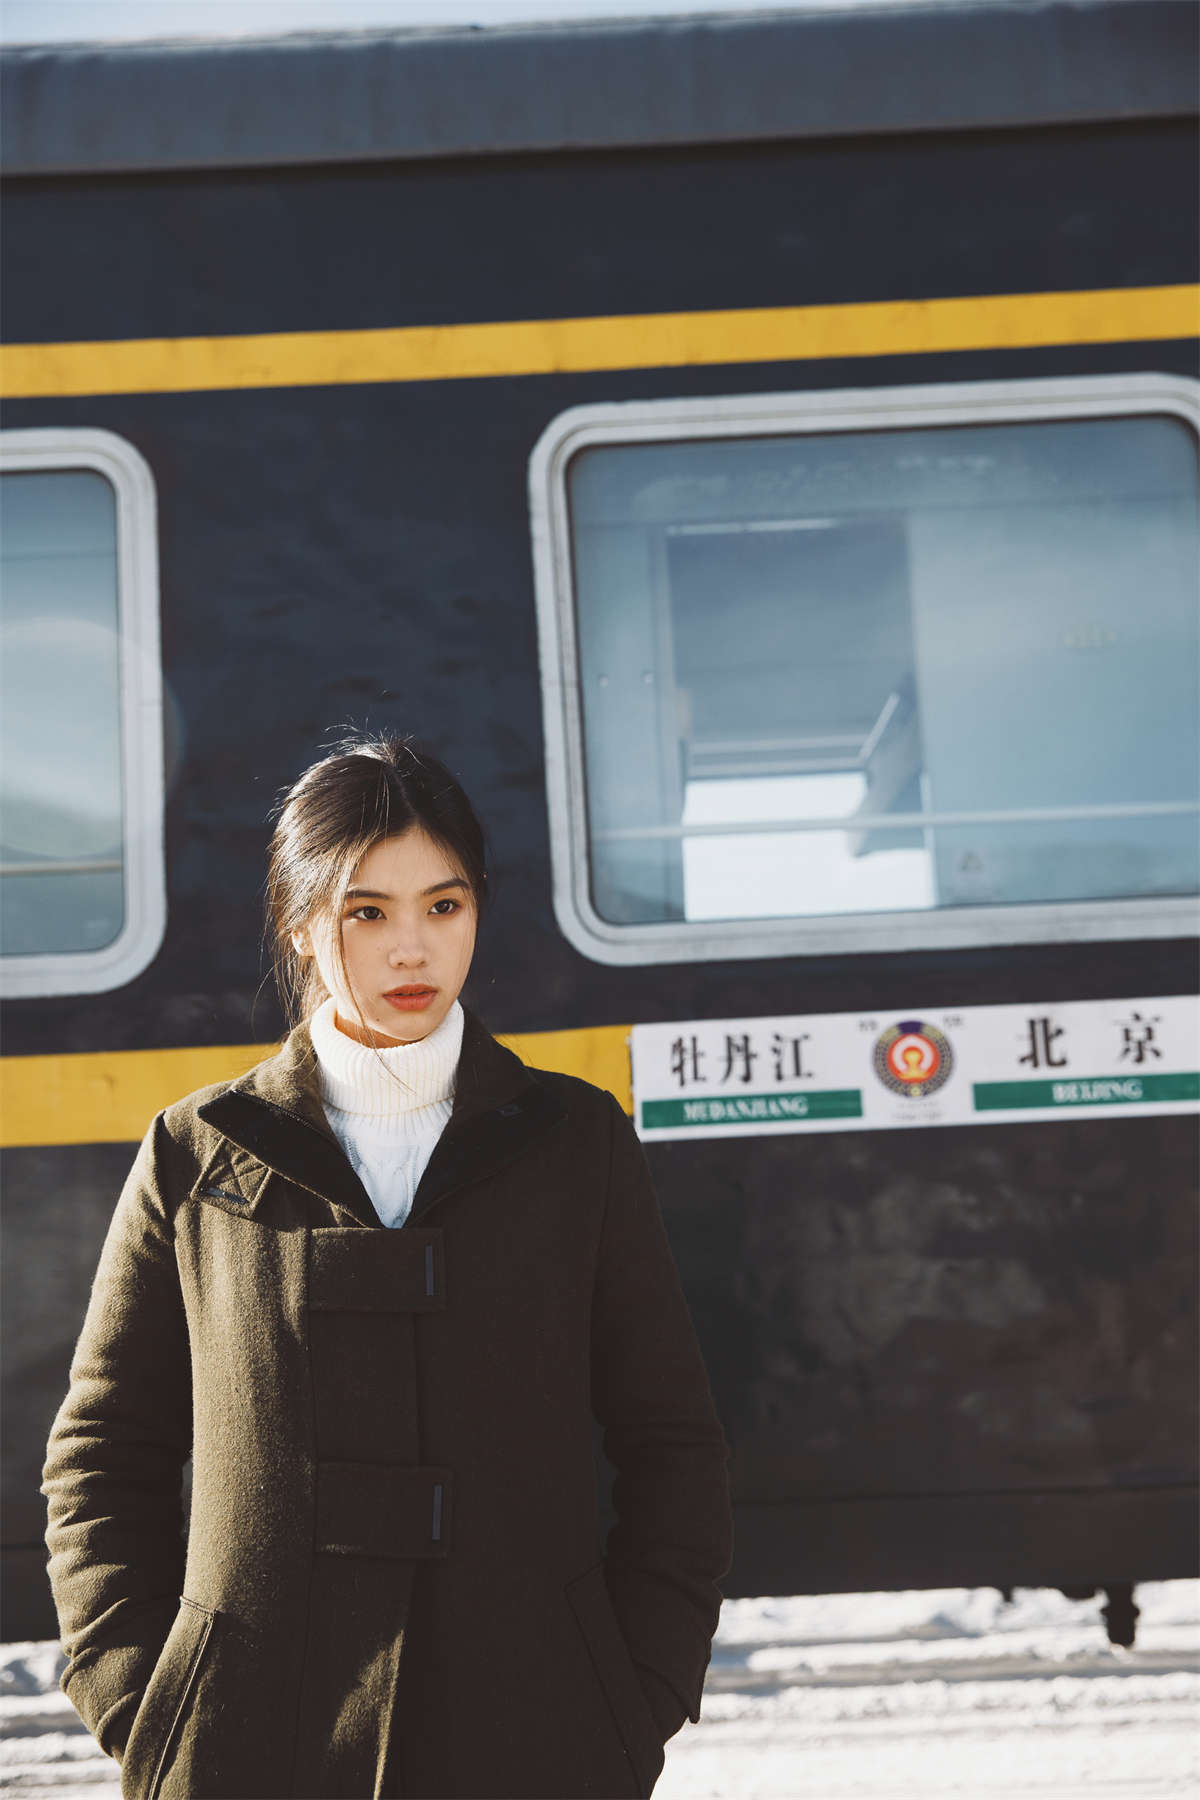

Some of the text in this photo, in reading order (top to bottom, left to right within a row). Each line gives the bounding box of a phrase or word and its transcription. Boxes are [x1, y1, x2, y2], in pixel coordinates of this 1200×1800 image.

[671, 1033, 815, 1087] 牡丹江
[1017, 1013, 1163, 1068] 北京
